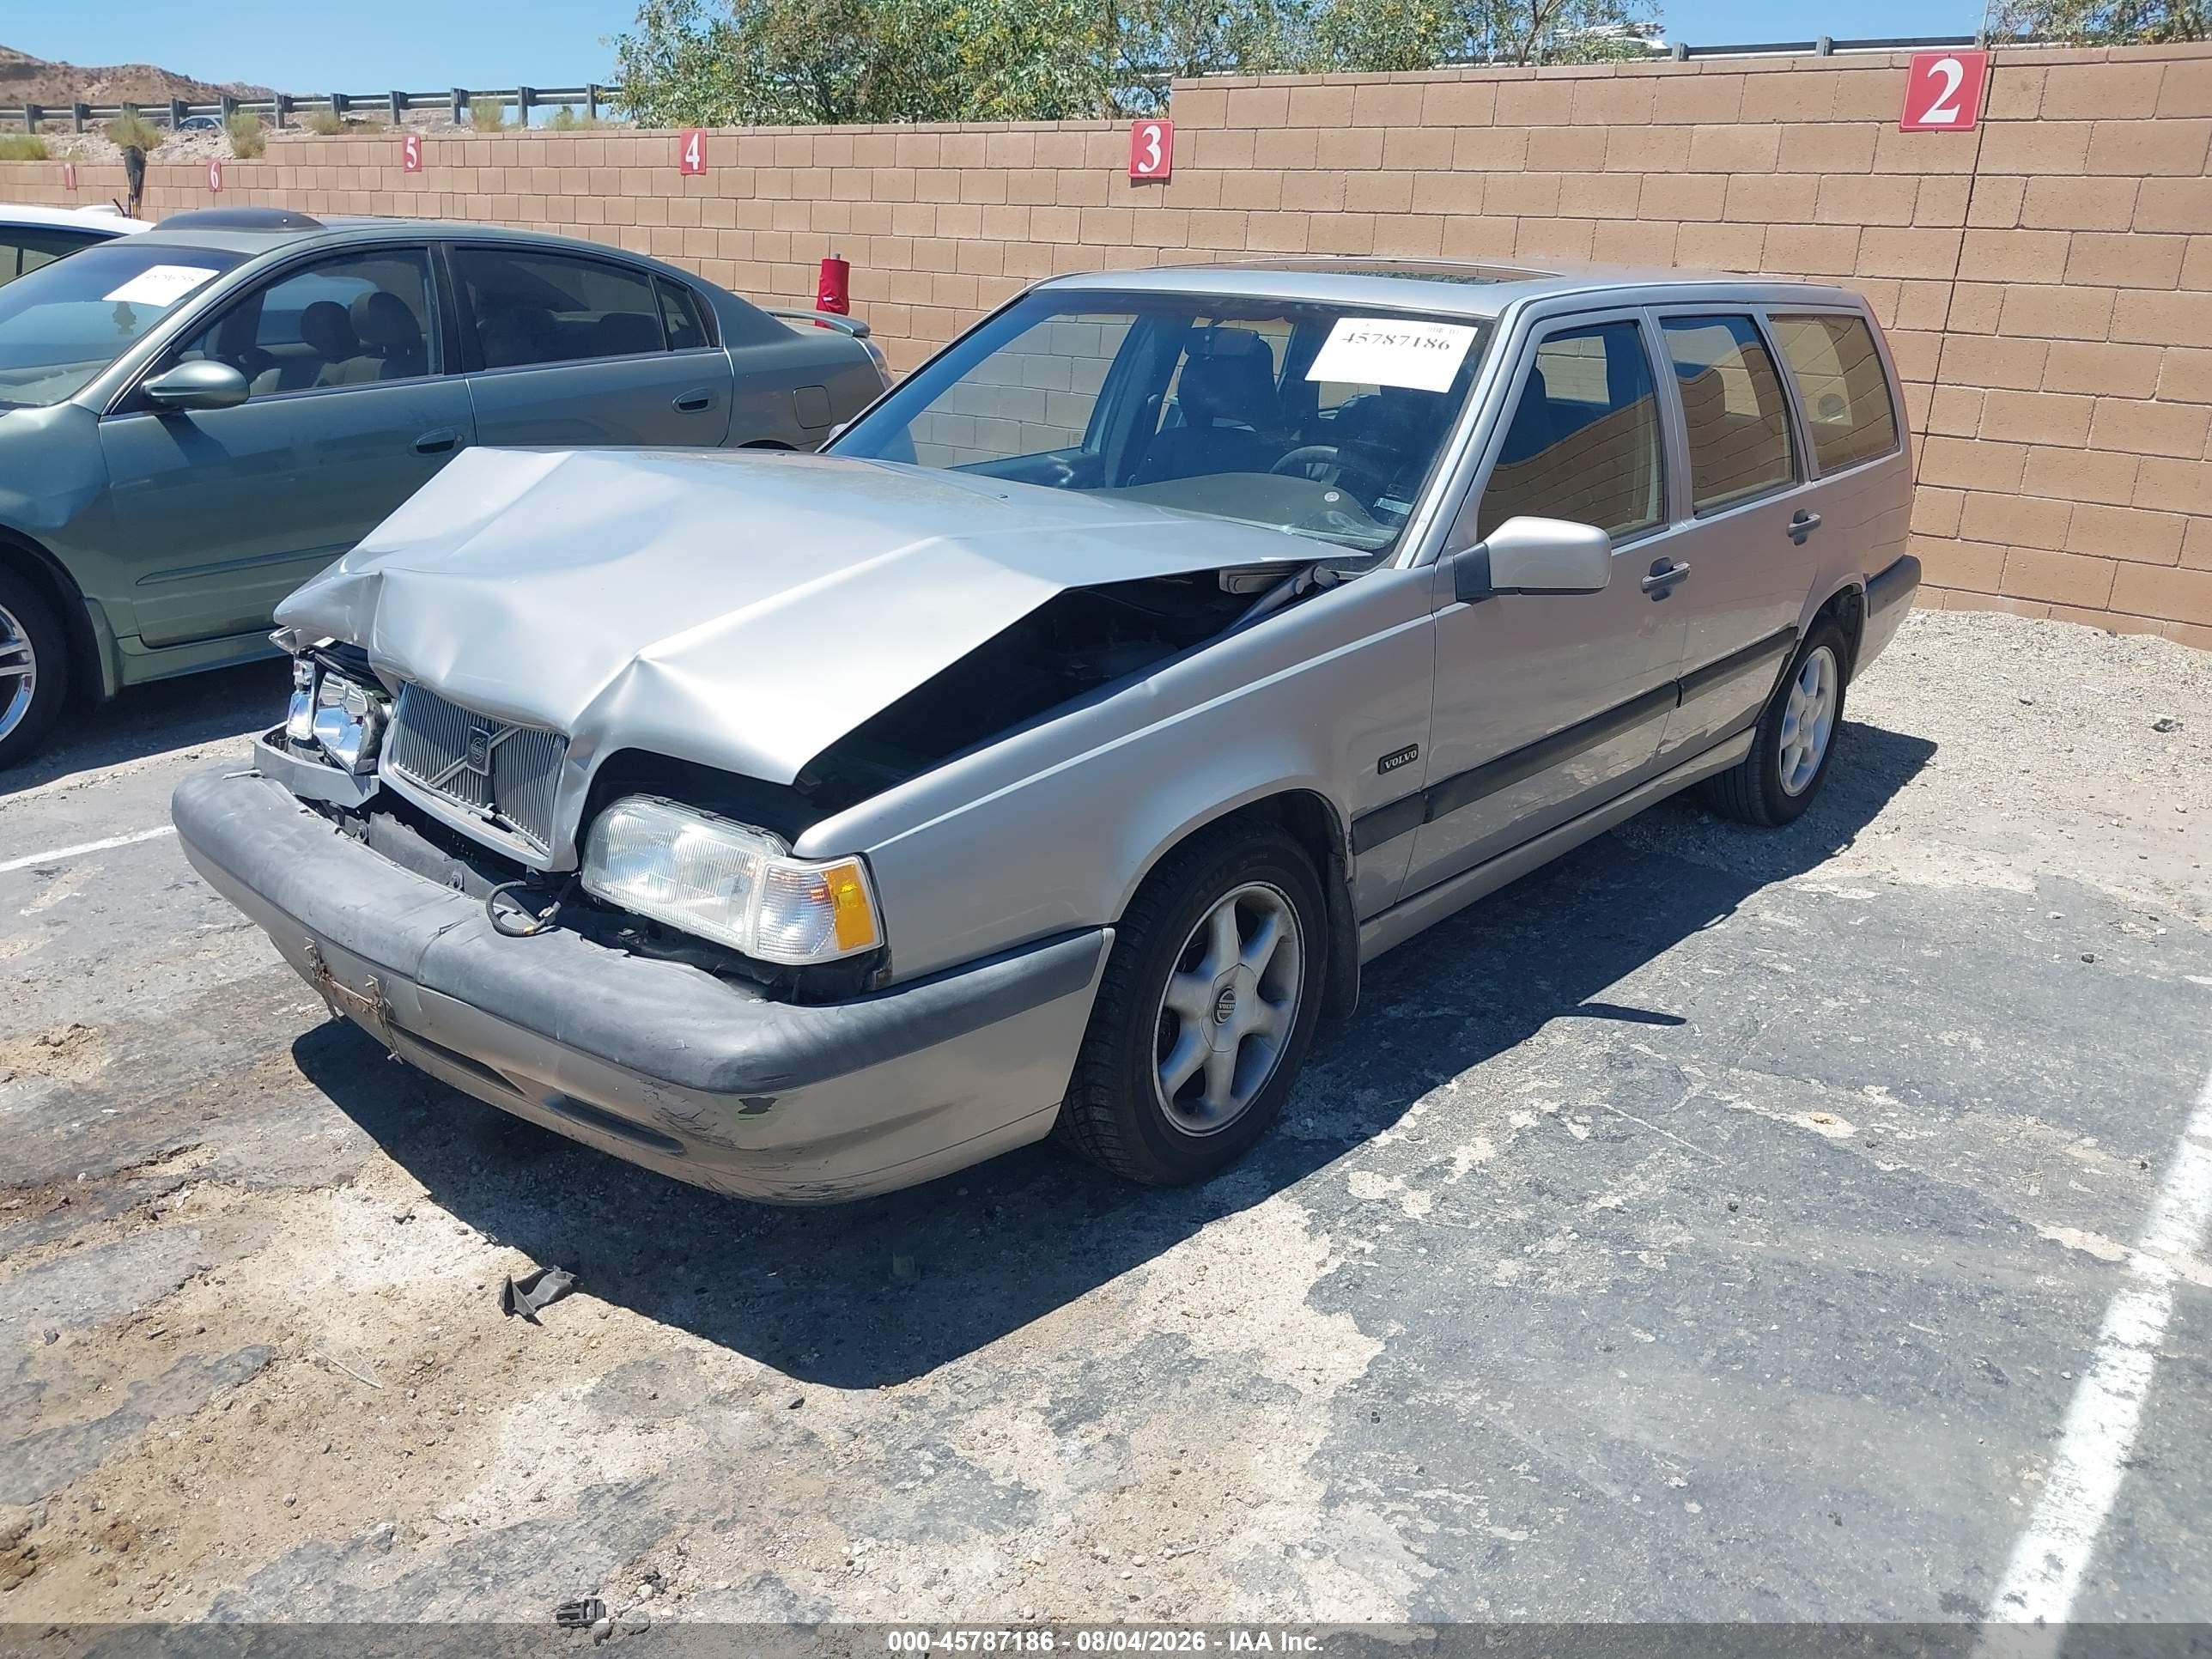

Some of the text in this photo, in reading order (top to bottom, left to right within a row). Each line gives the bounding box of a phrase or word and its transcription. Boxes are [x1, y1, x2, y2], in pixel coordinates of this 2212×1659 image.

[1917, 58, 1964, 123] 2
[406, 137, 417, 168] 5
[685, 132, 700, 170] 4
[1138, 125, 1162, 173] 3
[210, 162, 218, 189] 6
[1340, 331, 1451, 350] 45787186
[1384, 750, 1417, 769] VOLVO
